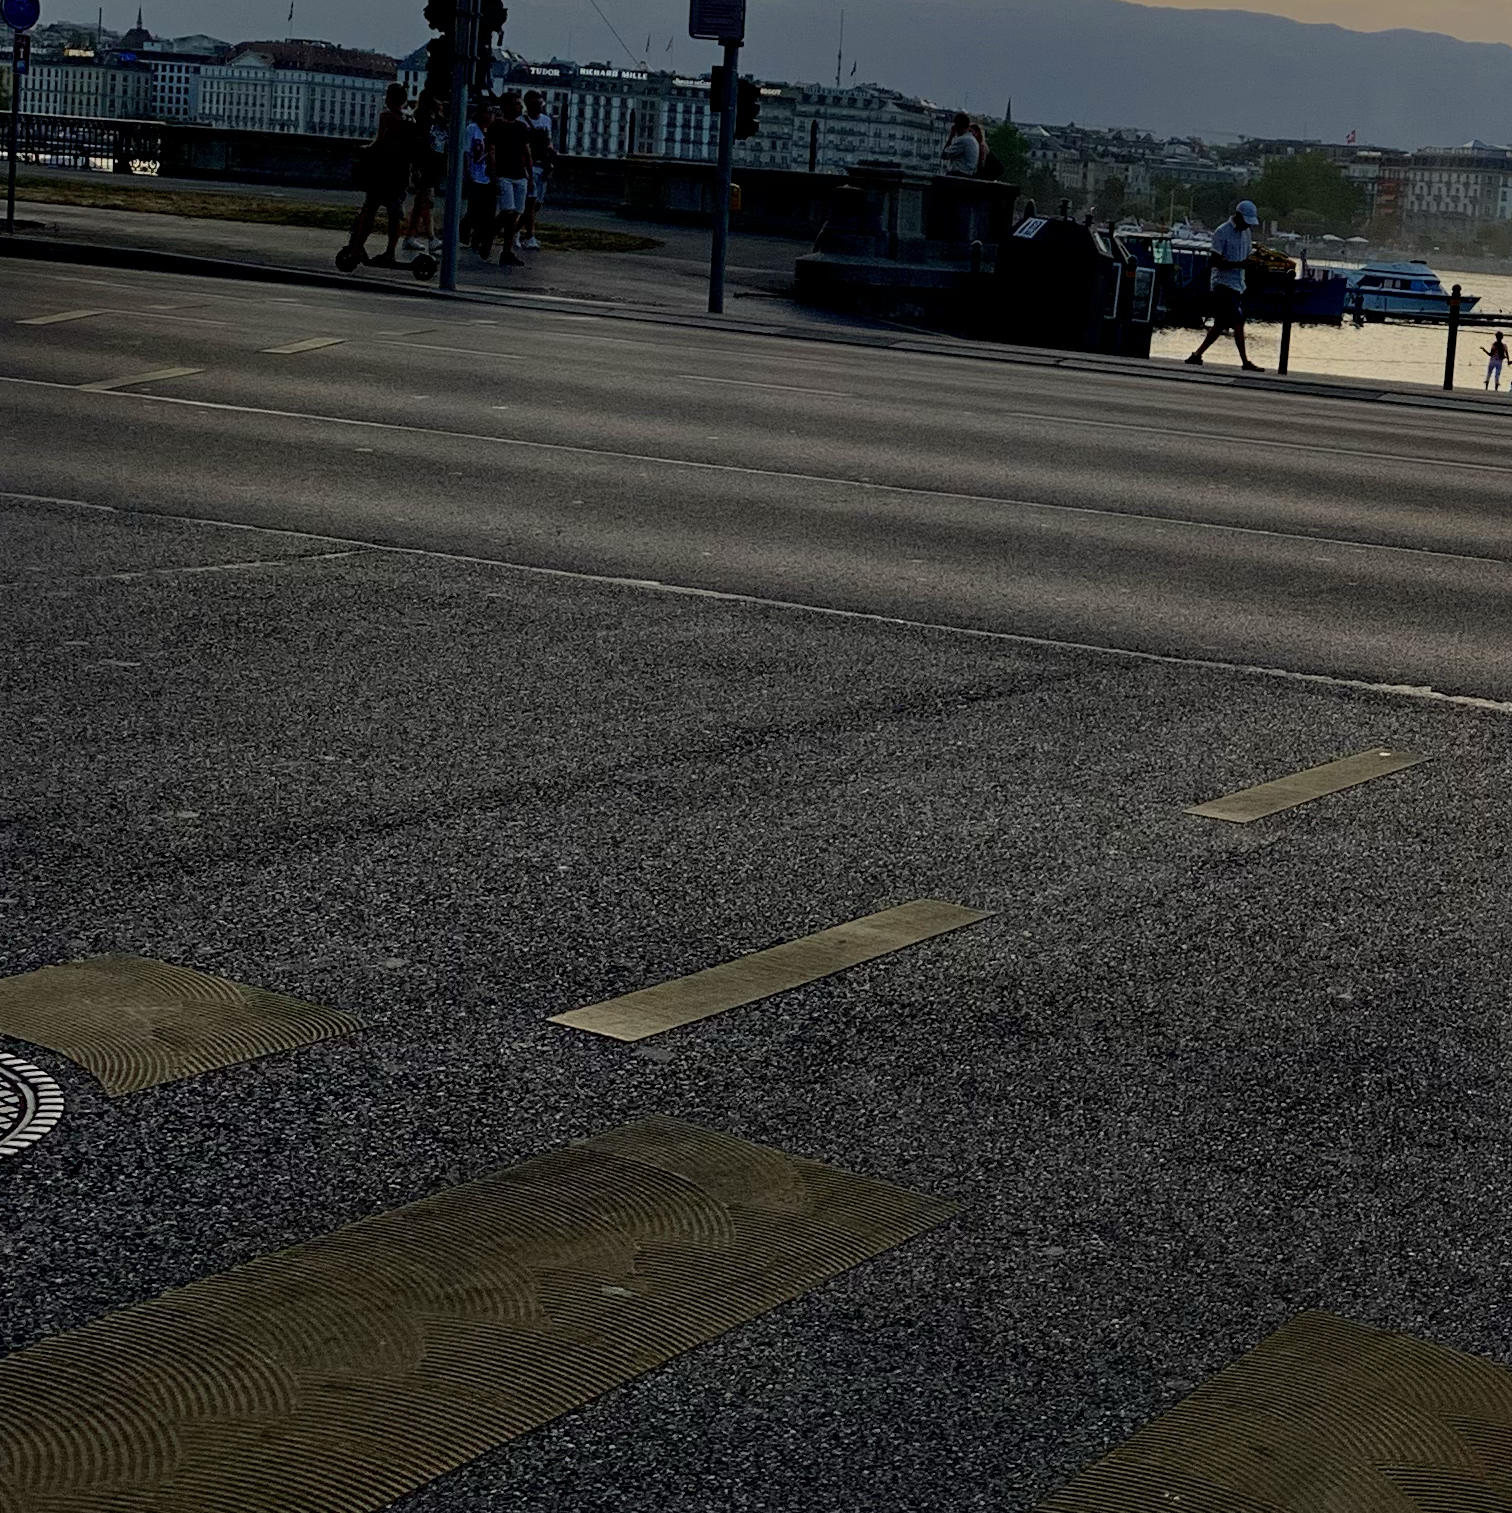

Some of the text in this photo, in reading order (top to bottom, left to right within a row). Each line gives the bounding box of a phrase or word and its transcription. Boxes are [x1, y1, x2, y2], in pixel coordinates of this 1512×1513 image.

[531, 67, 560, 76] TUDOR
[580, 68, 648, 80] RICHARD MILLE
